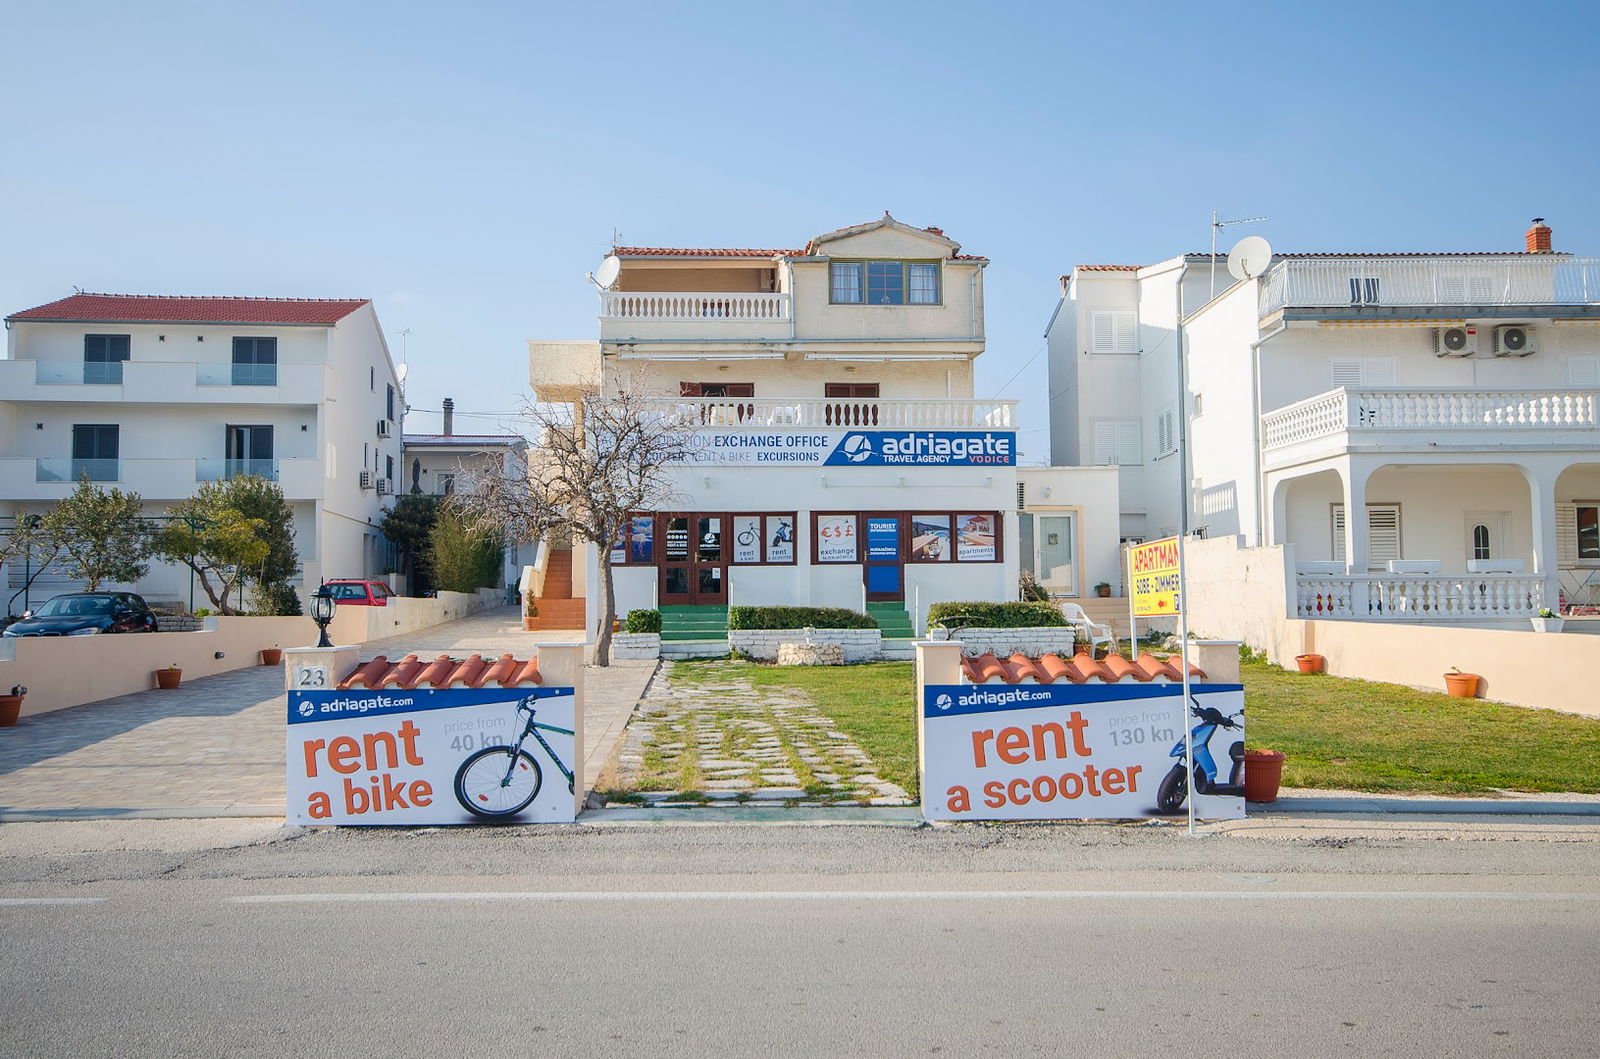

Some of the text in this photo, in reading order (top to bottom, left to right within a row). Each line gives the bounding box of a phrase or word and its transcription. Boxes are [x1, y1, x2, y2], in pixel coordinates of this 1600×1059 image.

[714, 435, 782, 447] EXCHANGE
[786, 435, 828, 447] OFFICE
[882, 433, 1010, 460] adriagate
[728, 452, 751, 462] BIKE
[757, 452, 819, 462] EXCURSIONS
[883, 455, 1010, 463] TRAVEL AGENCY VODICE
[820, 525, 854, 538] € $ £
[821, 548, 854, 556] exchange
[300, 669, 324, 686] 23
[321, 696, 413, 712] adriagate.com
[958, 689, 1051, 705] adriagate.com
[444, 717, 506, 735] price from
[1109, 711, 1170, 729] price from
[450, 732, 503, 752] 40 kn
[971, 711, 1092, 768] rent
[1109, 726, 1174, 747] 130 kn
[303, 720, 424, 778] rent
[308, 773, 433, 819] a bike
[946, 763, 1143, 813] a scooter
